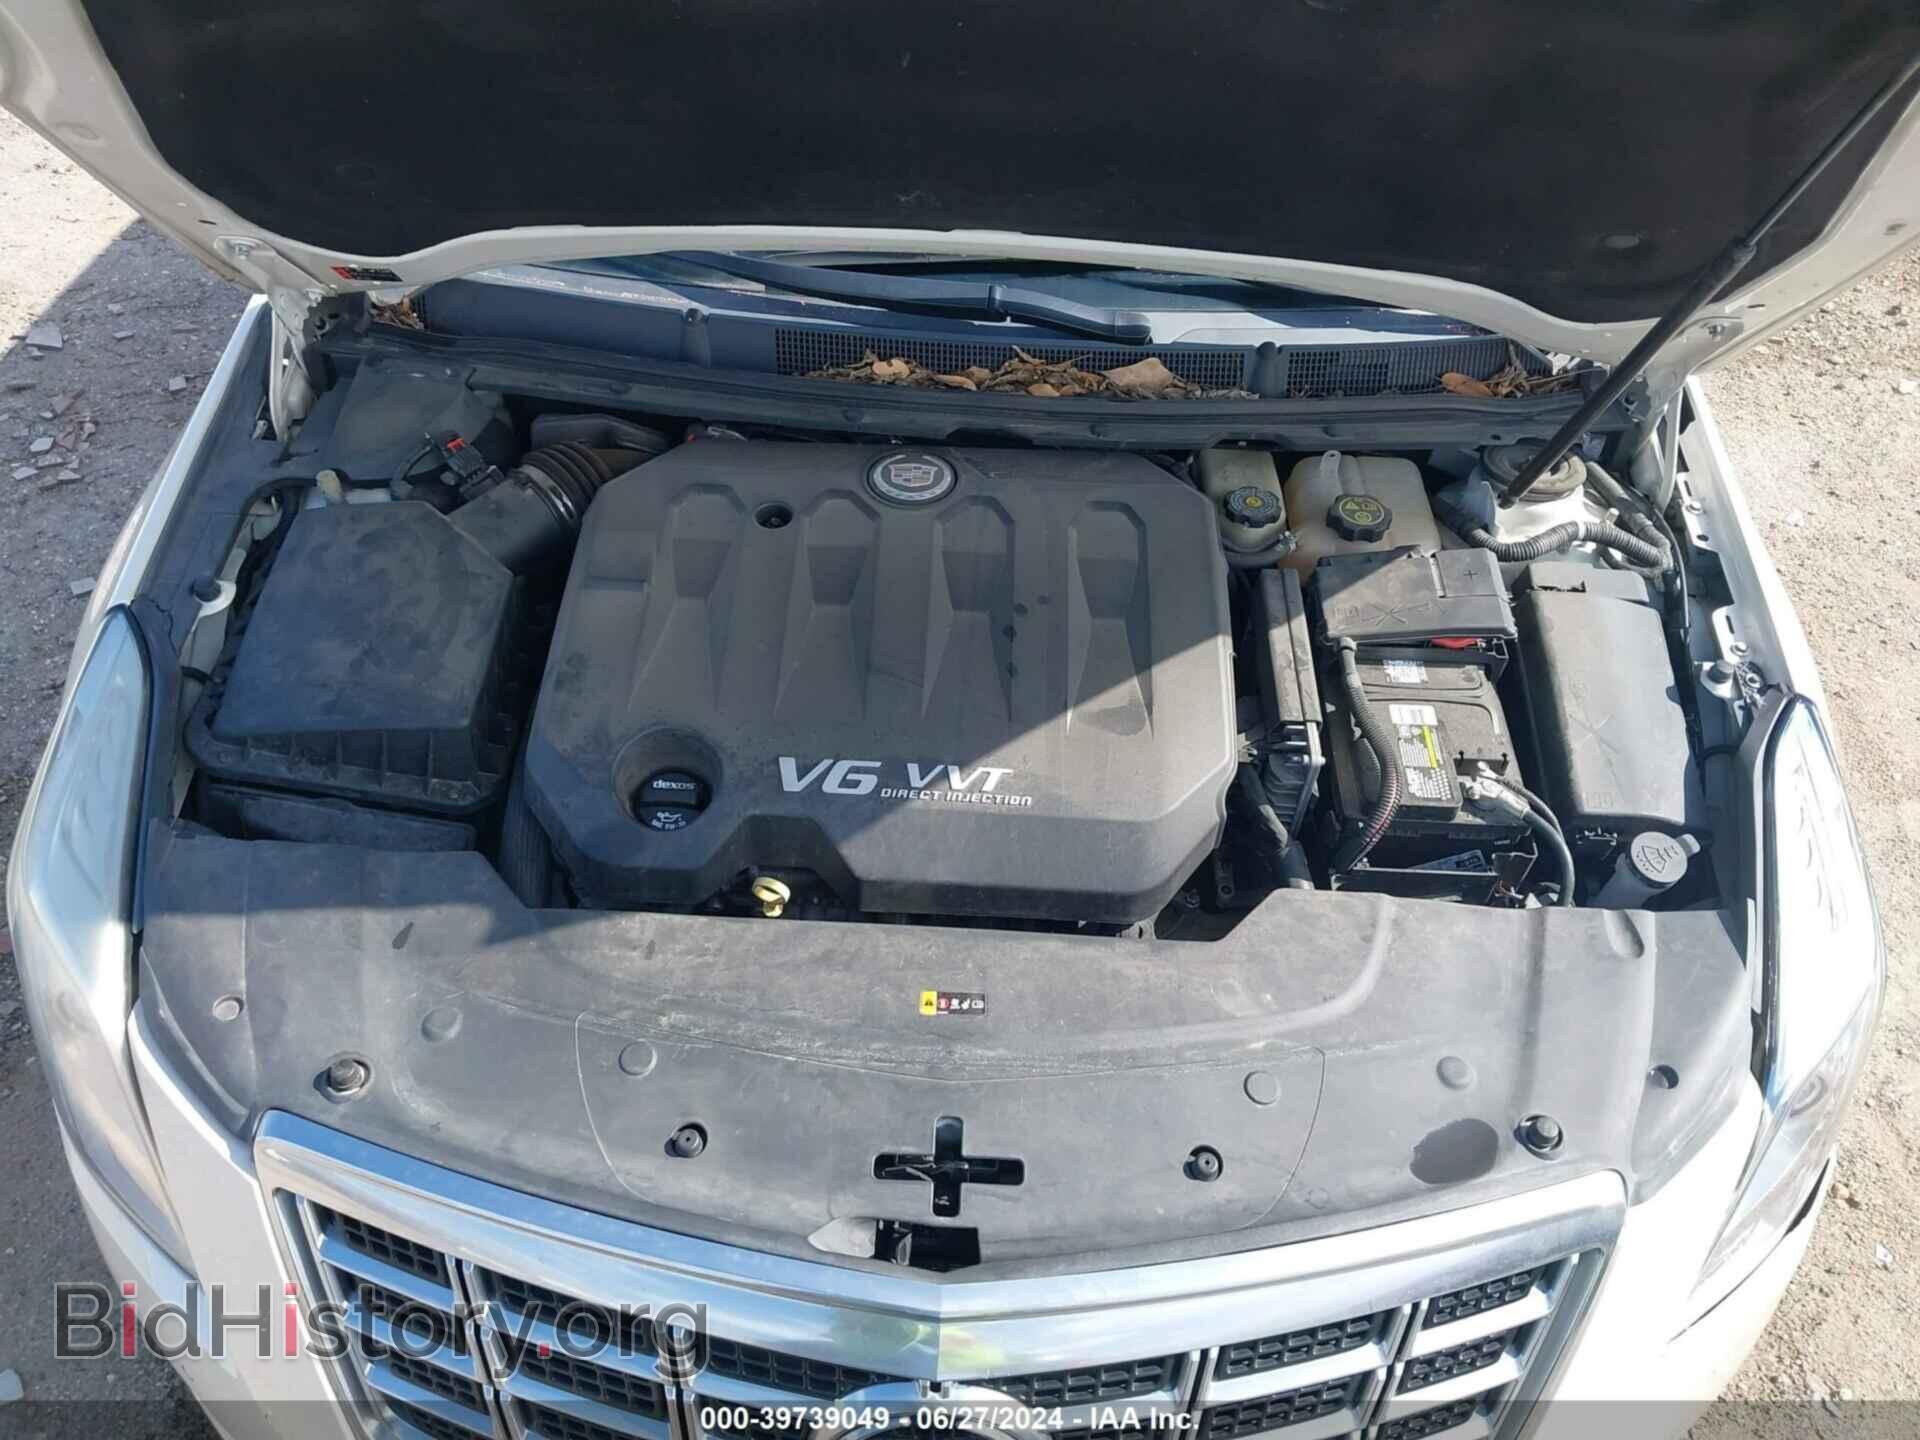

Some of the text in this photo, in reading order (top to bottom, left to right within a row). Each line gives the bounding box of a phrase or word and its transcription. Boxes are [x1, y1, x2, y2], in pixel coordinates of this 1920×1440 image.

[652, 780, 697, 790] dexos
[778, 756, 1014, 795] V6 VVT
[880, 787, 1033, 807] DIRECT INJECTION
